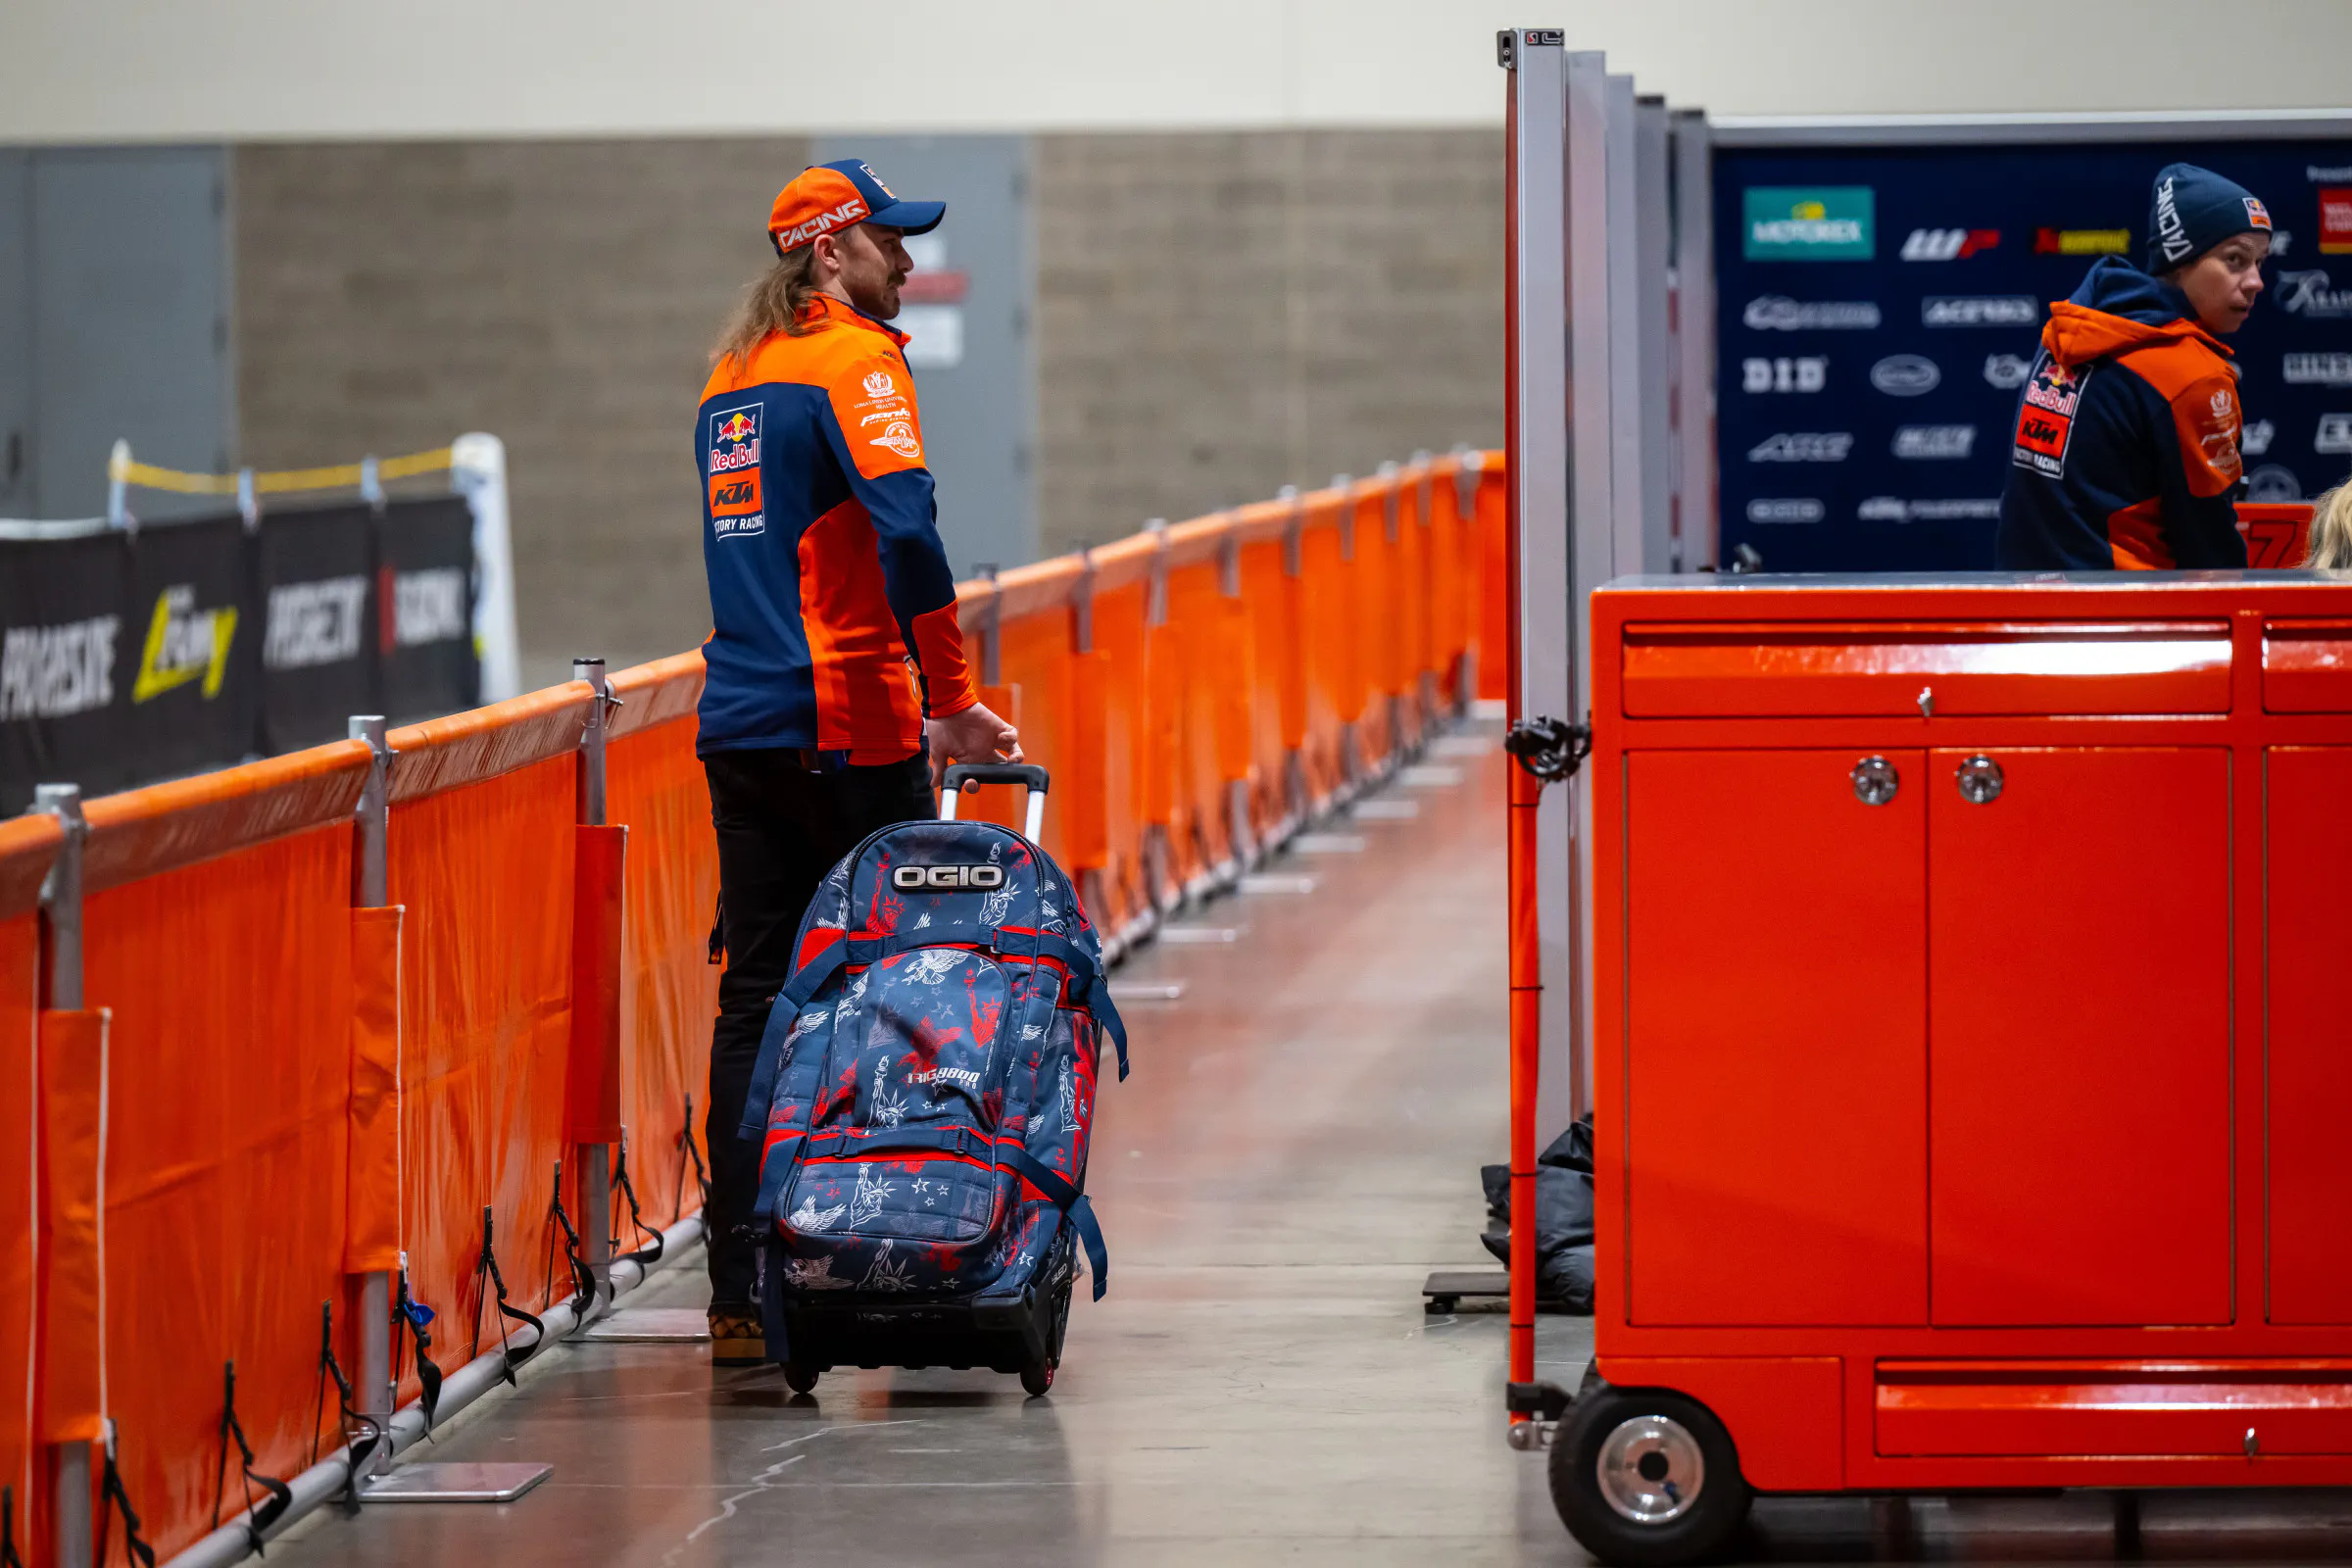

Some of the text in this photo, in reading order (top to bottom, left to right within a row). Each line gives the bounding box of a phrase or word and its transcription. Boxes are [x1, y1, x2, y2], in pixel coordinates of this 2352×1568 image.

[2022, 417, 2058, 445] KTM
[713, 480, 754, 507] KTM
[739, 514, 763, 530] RACING
[894, 866, 1003, 887] OGIO
